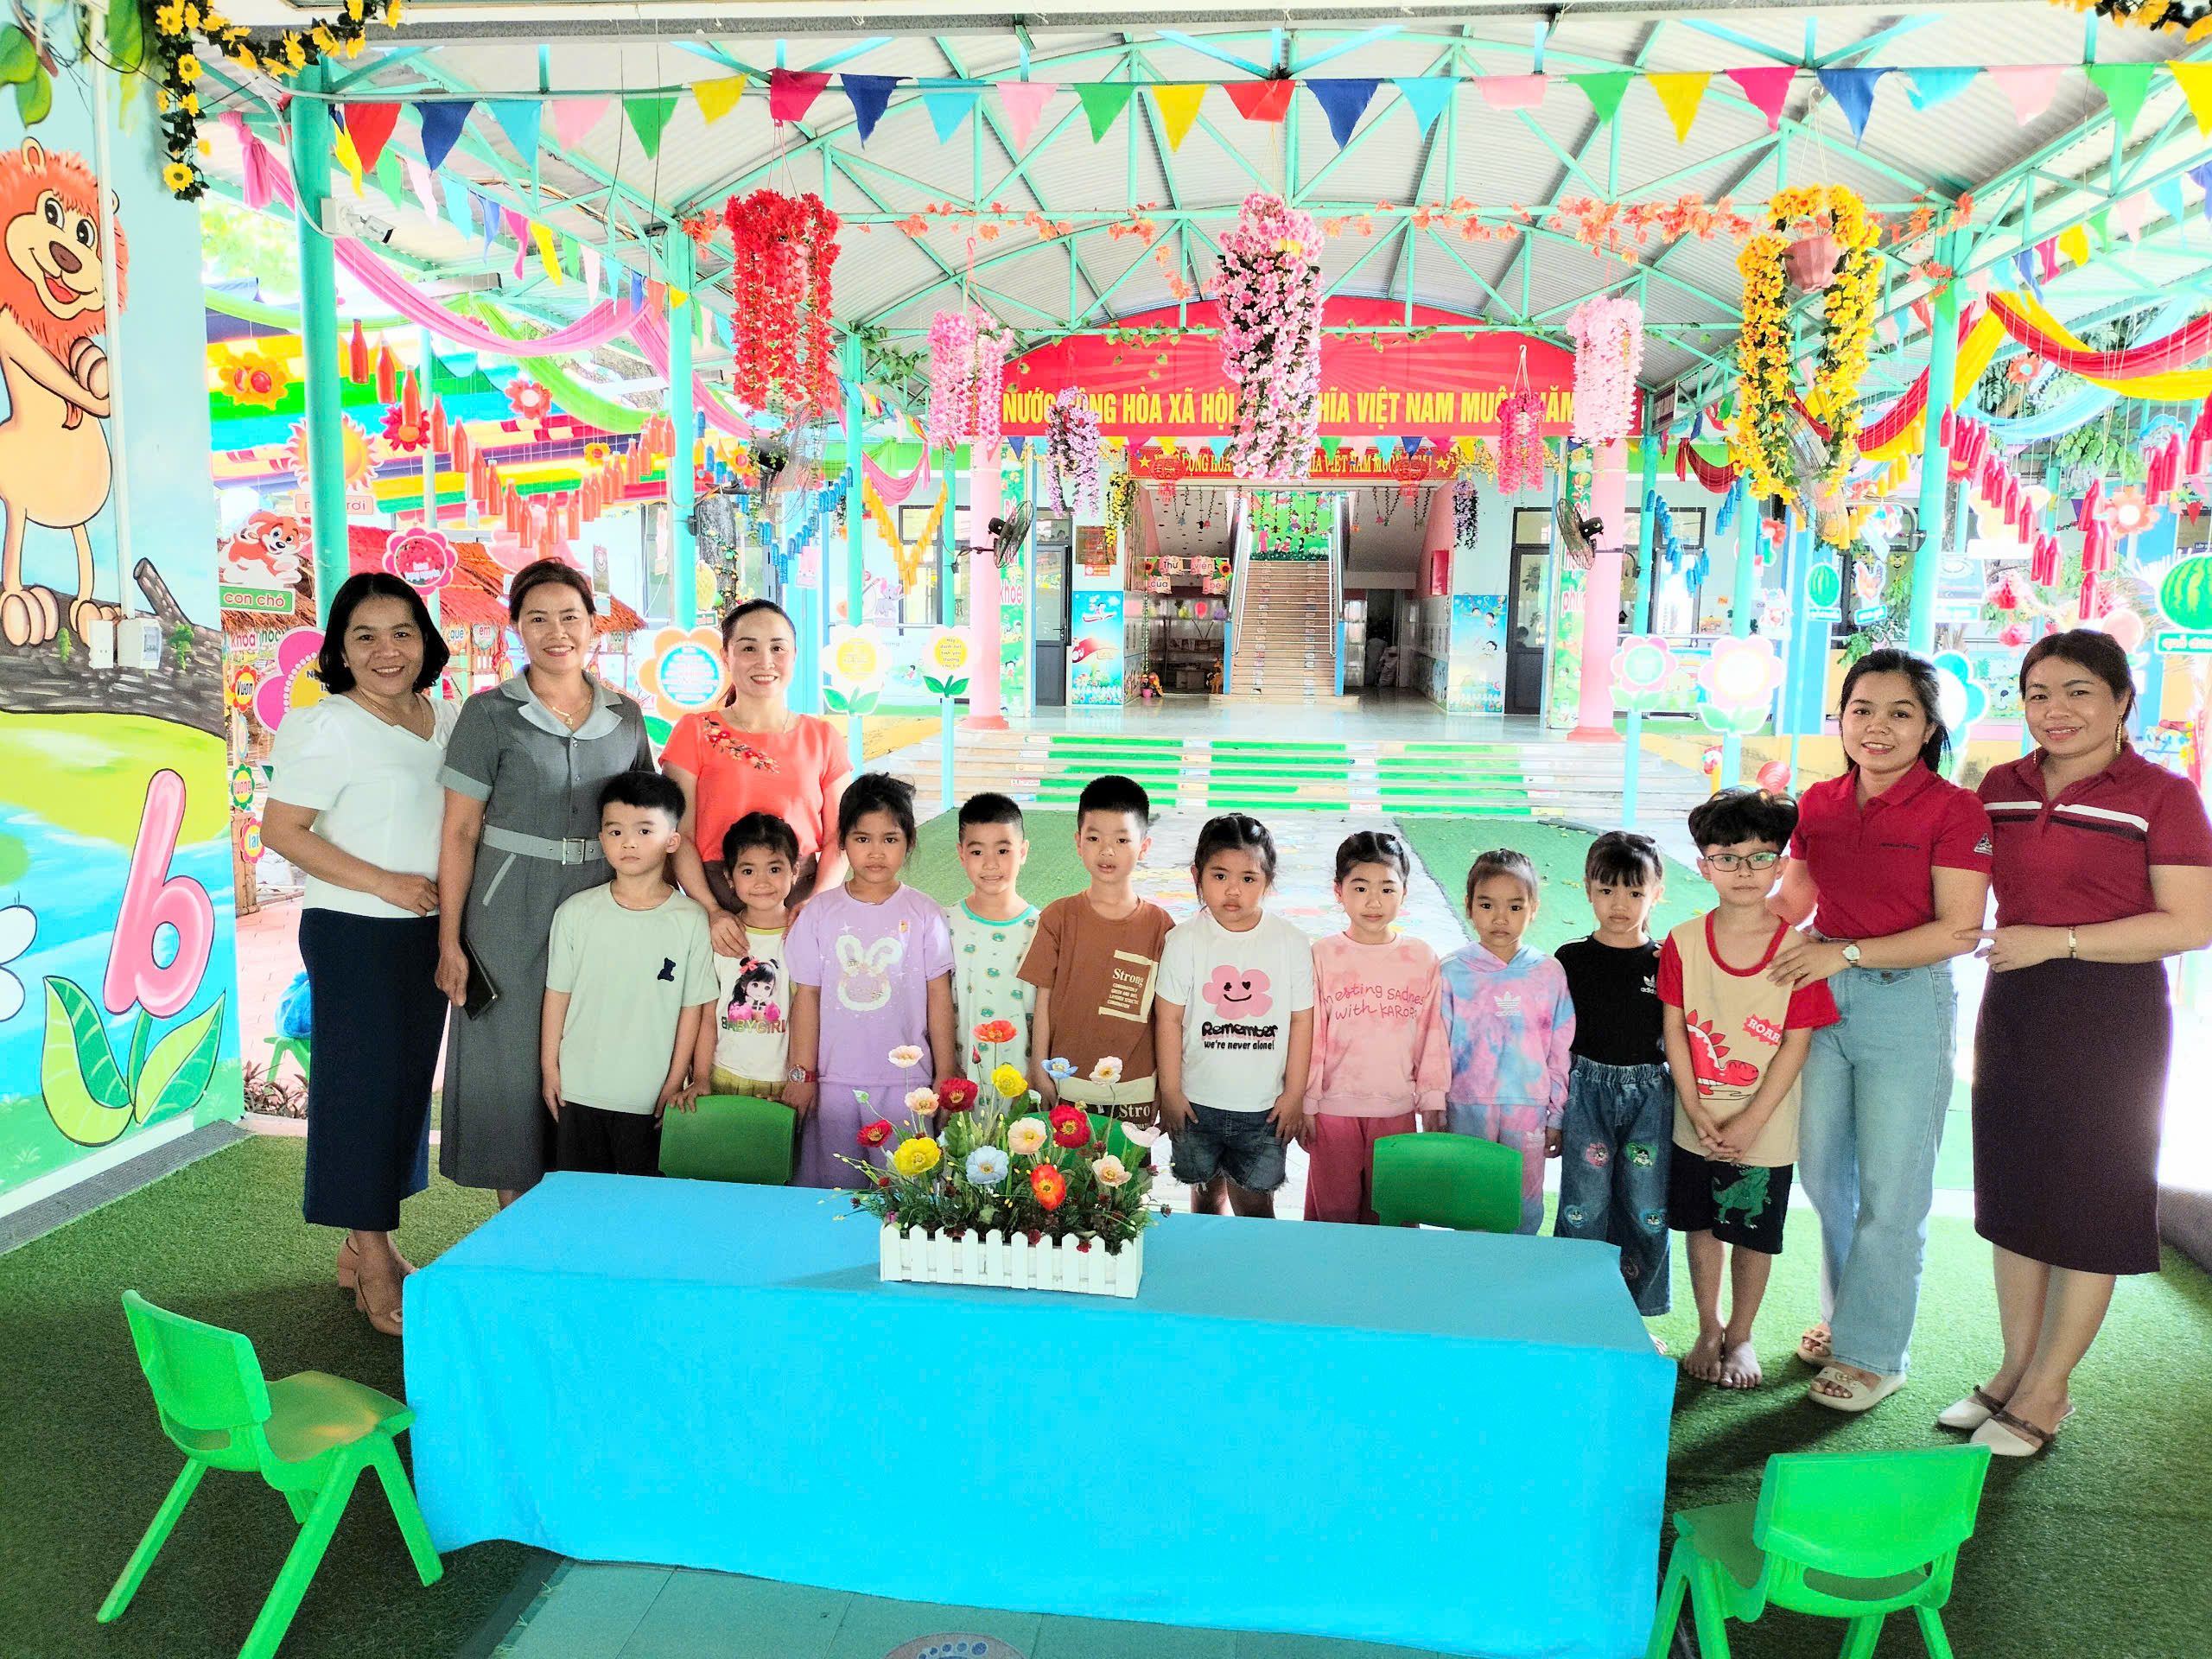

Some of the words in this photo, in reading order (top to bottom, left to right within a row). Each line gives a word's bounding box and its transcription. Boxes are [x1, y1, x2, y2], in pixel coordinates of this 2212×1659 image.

[1122, 386, 1162, 423] HÒA
[1168, 387, 1195, 423] XÃ
[1201, 387, 1235, 429] HỘI
[1357, 386, 1401, 429] VIỆT
[1405, 392, 1454, 423] NAM
[1460, 386, 1516, 423] MUÔ
[224, 593, 252, 605] con
[257, 594, 284, 607] chó
[1112, 968, 1144, 988] Strong
[1335, 999, 1377, 1020] with
[1201, 1021, 1278, 1039] Remember
[1746, 1018, 1781, 1042] ROAR
[1204, 1039, 1225, 1050] we're
[1227, 1041, 1251, 1050] never
[1253, 1040, 1274, 1051] alone!
